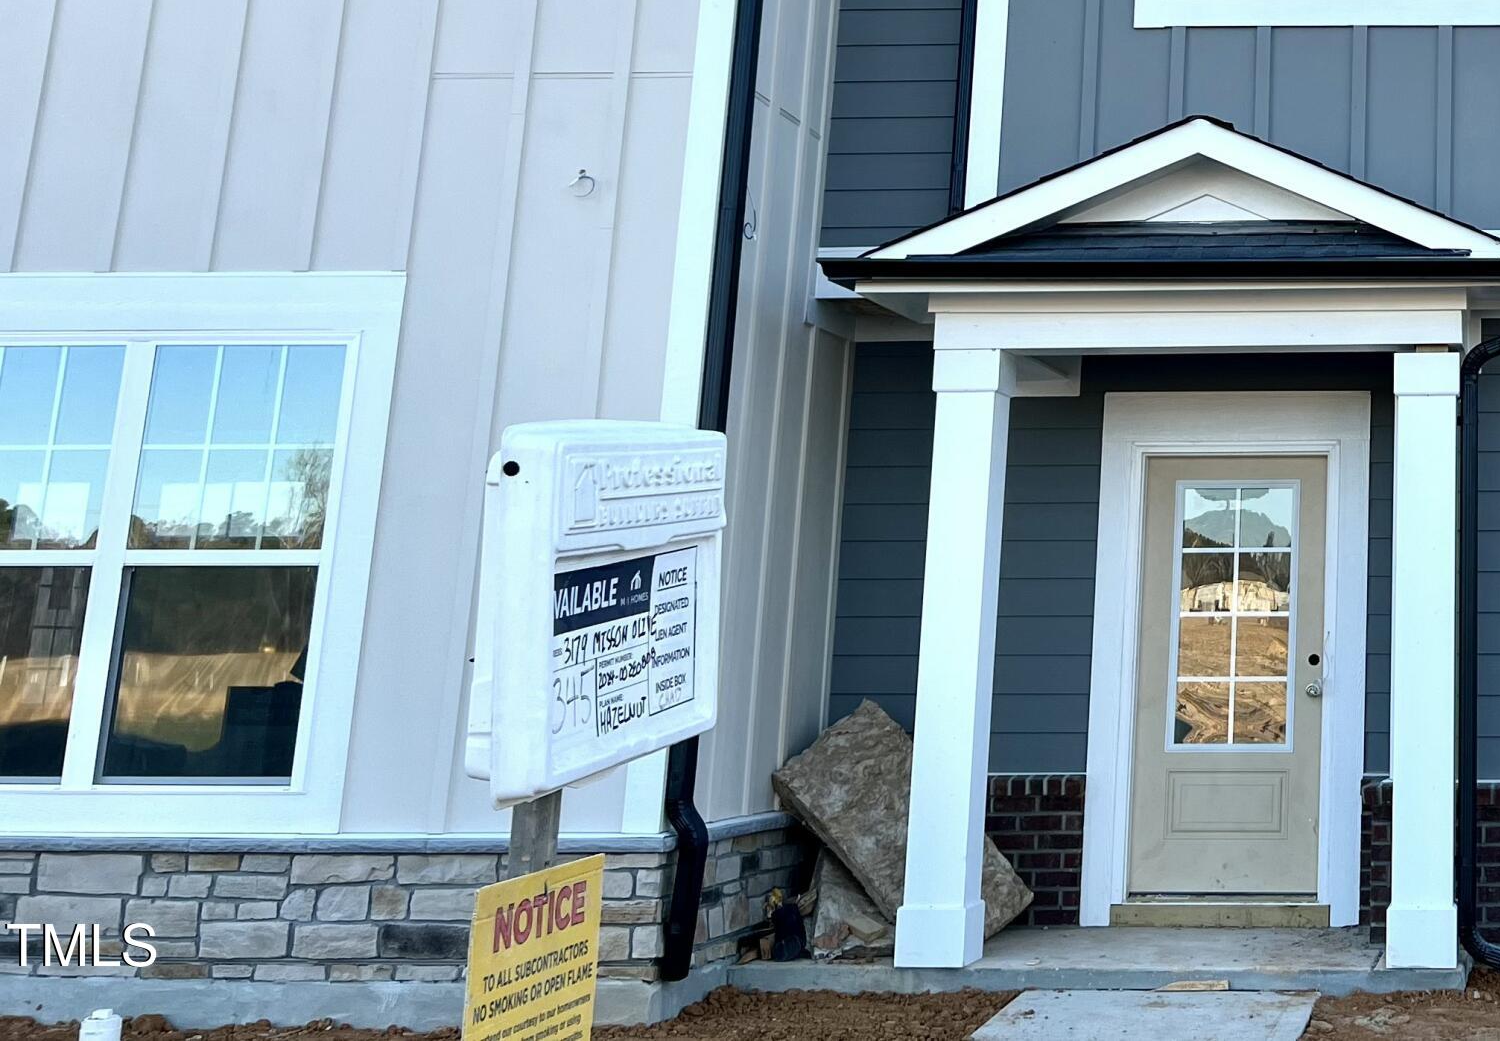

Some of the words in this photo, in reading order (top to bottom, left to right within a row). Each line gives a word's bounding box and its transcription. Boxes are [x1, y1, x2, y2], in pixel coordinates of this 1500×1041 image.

[659, 566, 688, 588] NOTICE
[654, 596, 689, 615] DESIGNATED
[655, 628, 667, 642] LIEN
[668, 622, 688, 637] AGENT
[564, 633, 588, 666] 3179
[652, 646, 690, 669] INFORMATION
[655, 676, 673, 694] INSIDE
[674, 673, 687, 687] BOX
[600, 696, 647, 735] HAZELNUT
[493, 880, 587, 954] NOTICE
[483, 974, 495, 994] TO
[496, 968, 513, 989] ALL
[514, 939, 589, 981] SUBCONTRACTORS
[472, 1004, 487, 1026] NO
[488, 987, 529, 1018] SMOKING
[530, 982, 542, 1001] OR
[544, 972, 566, 996] OPEN
[567, 962, 593, 987] FLAME
